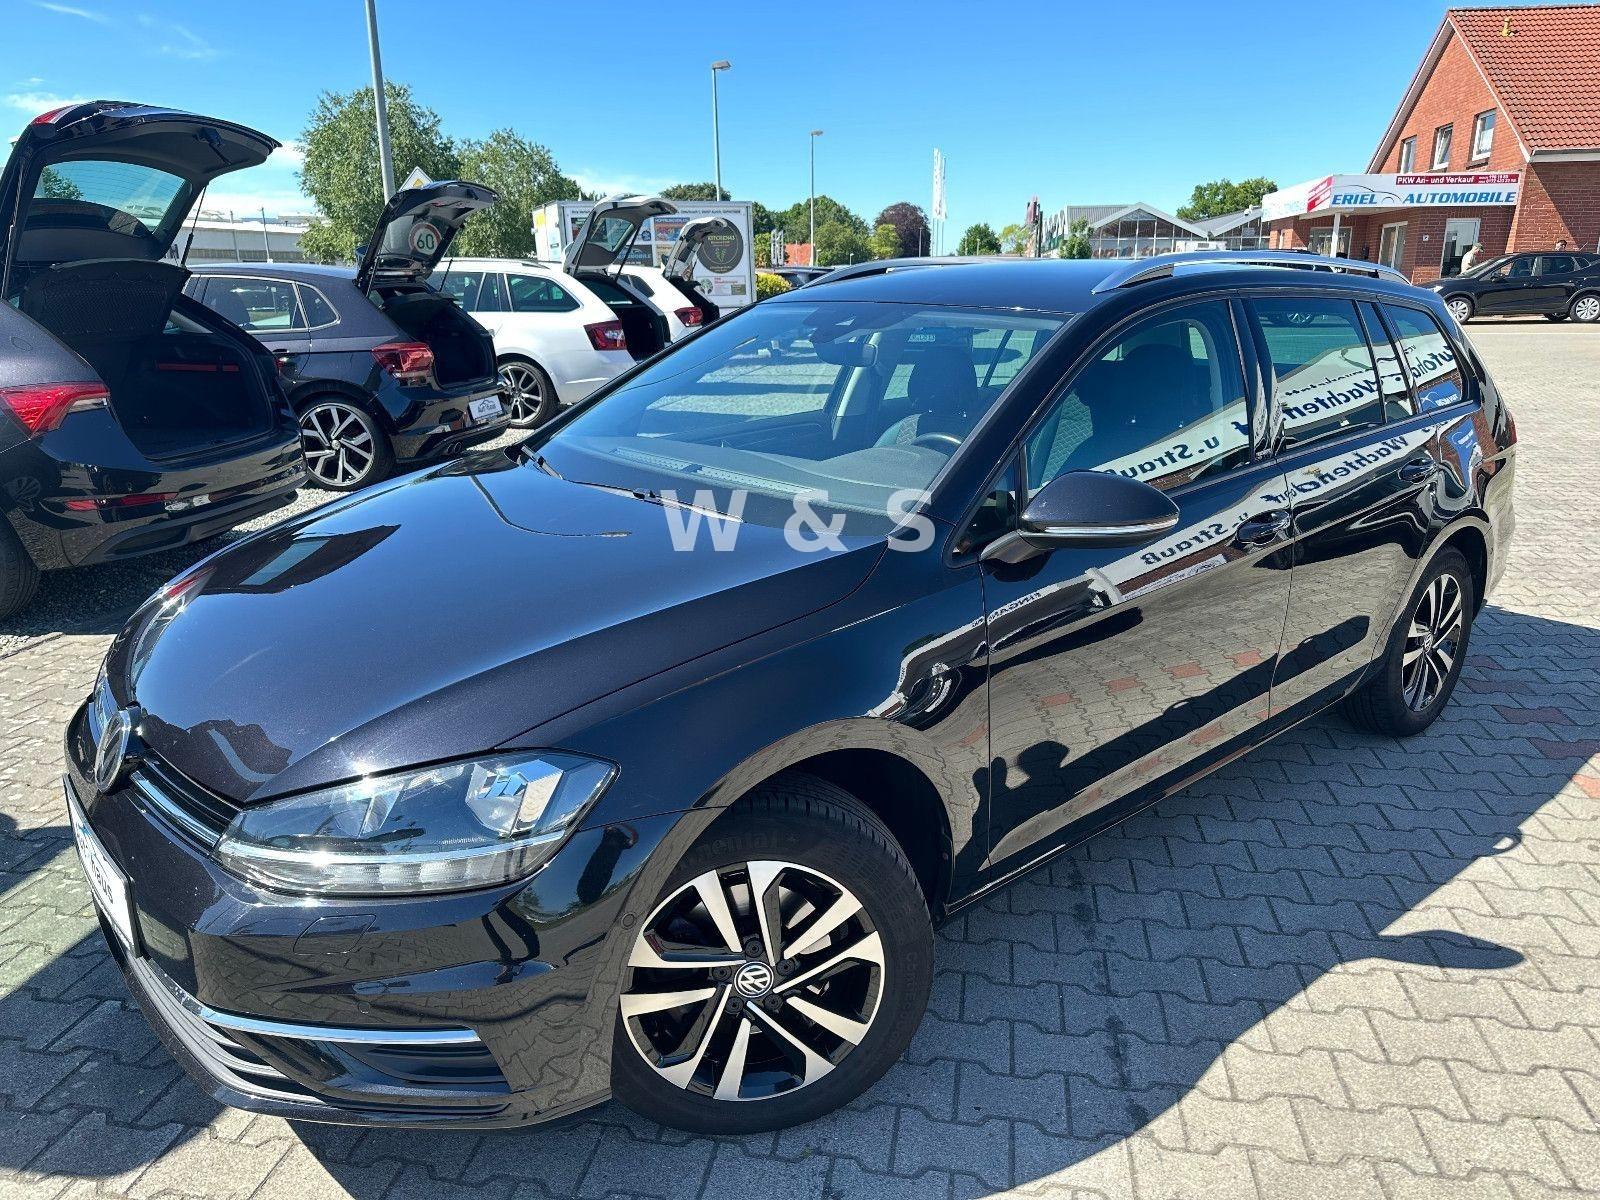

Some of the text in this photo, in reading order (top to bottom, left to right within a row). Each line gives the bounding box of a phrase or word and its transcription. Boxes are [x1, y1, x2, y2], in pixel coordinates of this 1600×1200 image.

[1397, 176, 1414, 184] PKW
[1430, 176, 1445, 184] und
[1445, 175, 1475, 184] Verkauf
[1331, 191, 1517, 205] ERIEL AUTOMOBILE
[416, 234, 435, 250] 60
